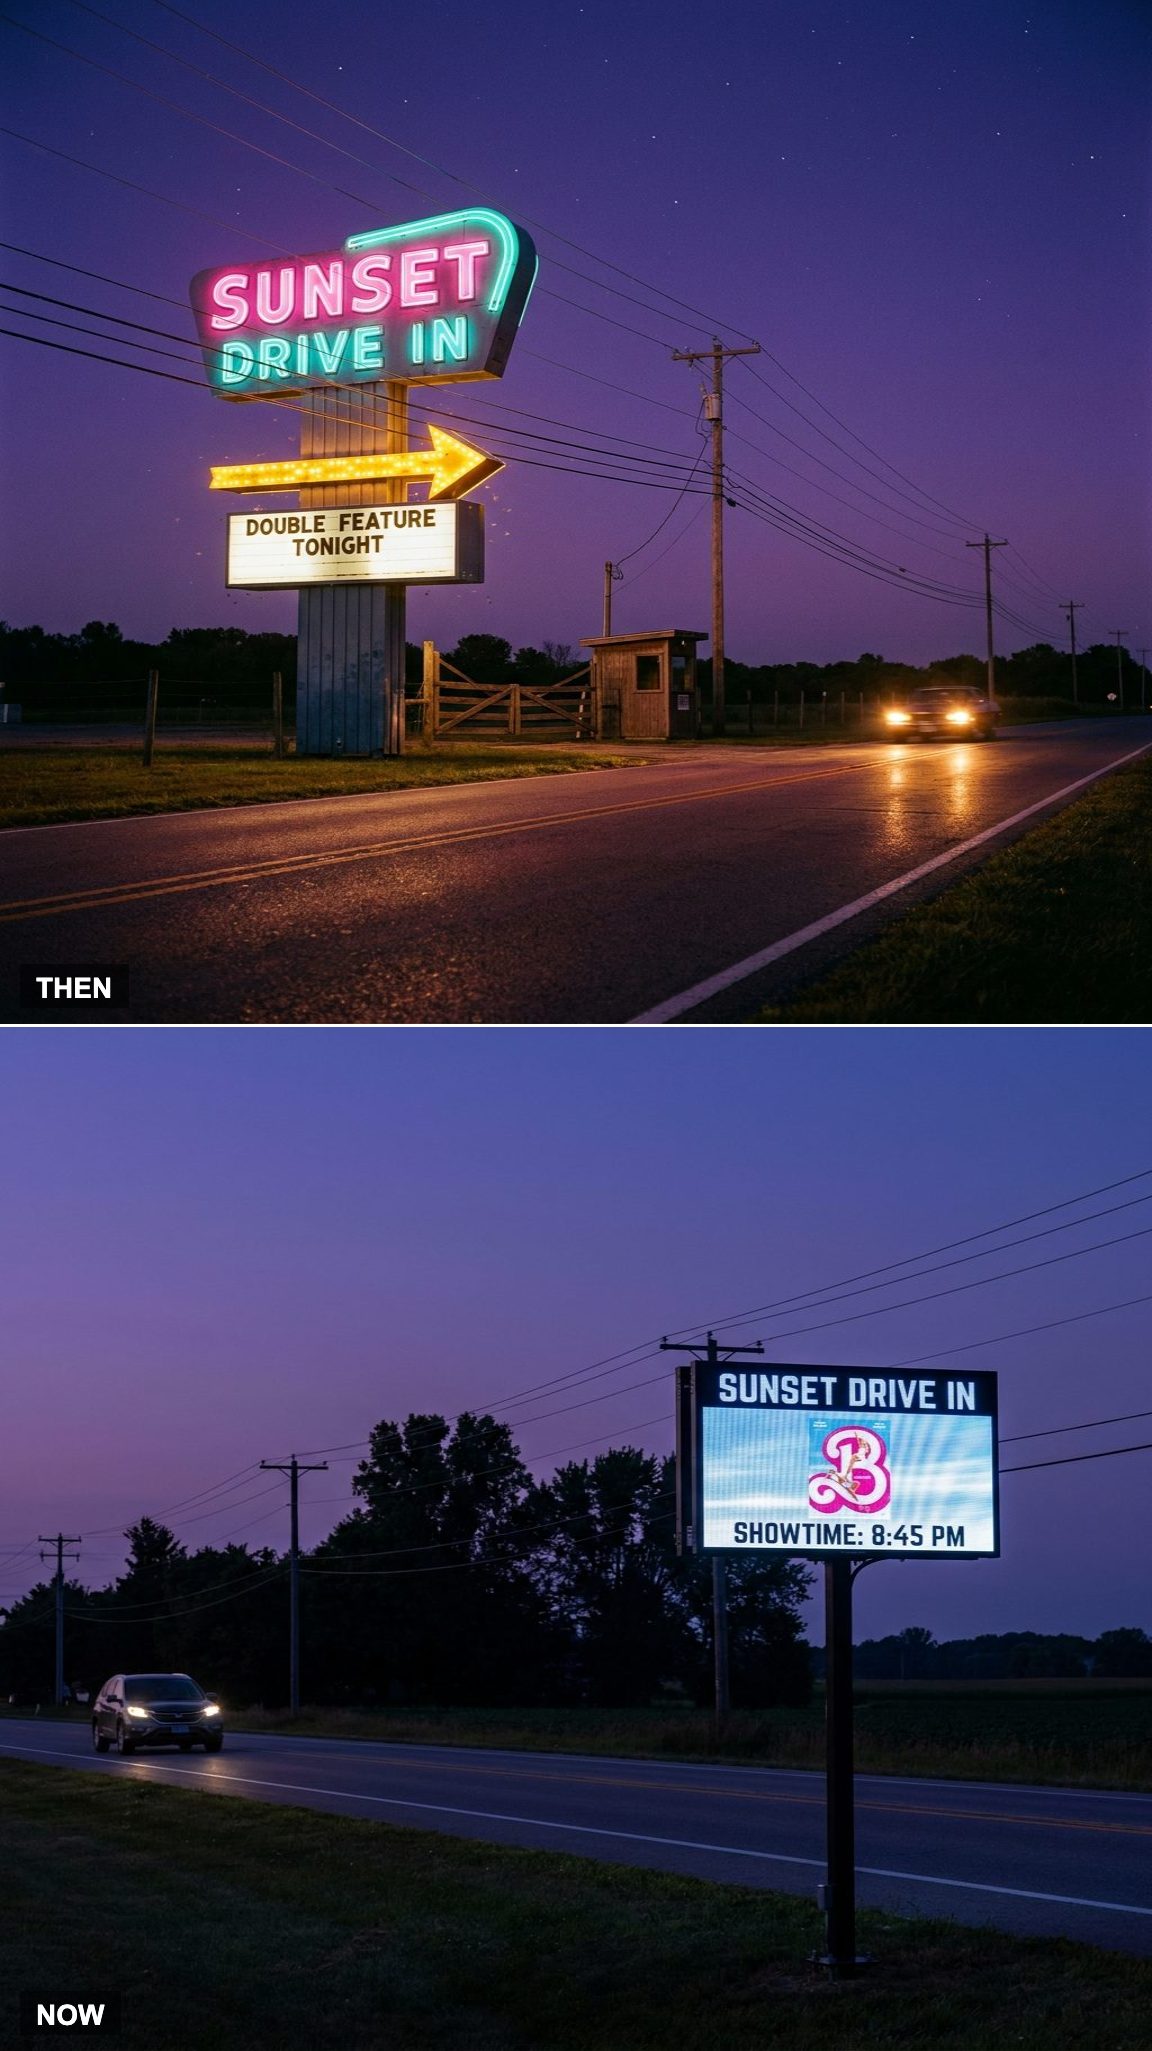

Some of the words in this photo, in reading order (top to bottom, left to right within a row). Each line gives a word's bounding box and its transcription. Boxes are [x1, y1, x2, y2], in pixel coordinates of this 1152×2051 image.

[211, 240, 490, 330] SUNSET
[222, 325, 384, 384] DRIVE
[412, 315, 468, 365] IN
[246, 515, 326, 536] DOUBLE
[339, 509, 436, 531] FEATURE
[292, 535, 384, 557] TONIGHT
[719, 1373, 837, 1405] SUNSET
[849, 1377, 936, 1409] DRIVE
[947, 1381, 975, 1411] IN
[809, 1427, 890, 1512] B
[734, 1522, 863, 1545] SHOWTIME:
[872, 1524, 924, 1547] 8:45
[932, 1525, 965, 1547] PM
